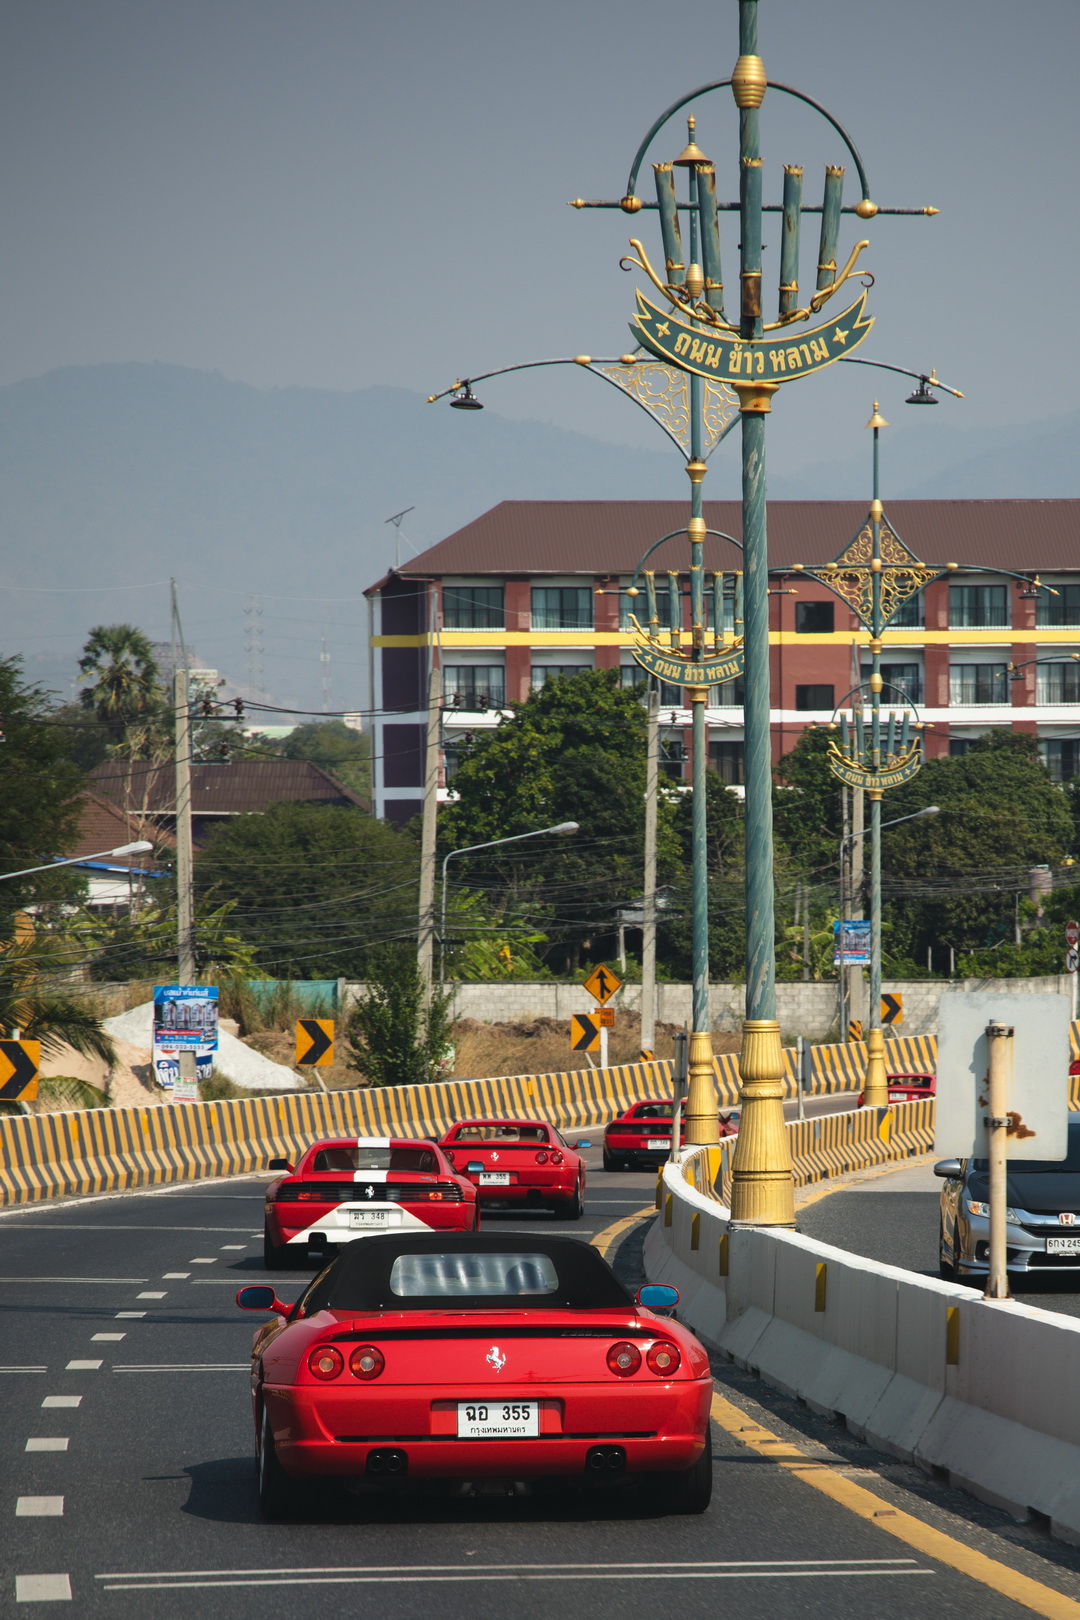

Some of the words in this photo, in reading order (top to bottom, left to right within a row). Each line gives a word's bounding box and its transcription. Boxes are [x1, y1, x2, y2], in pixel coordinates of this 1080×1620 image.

[673, 332, 723, 369] ถนน
[729, 342, 765, 374] ข้าว
[768, 336, 830, 372] หลาม
[654, 660, 681, 679] ถนน
[684, 664, 704, 681] ข้าว
[706, 660, 739, 680] หลาม
[844, 772, 863, 784] ถนน
[866, 774, 879, 786] ข้าว
[881, 772, 904, 786] หลาม
[371, 1212, 385, 1220] 348
[466, 1405, 488, 1421] ฉอ
[502, 1405, 530, 1421] 355
[470, 1426, 526, 1436] กรุงเทพมหานคร
